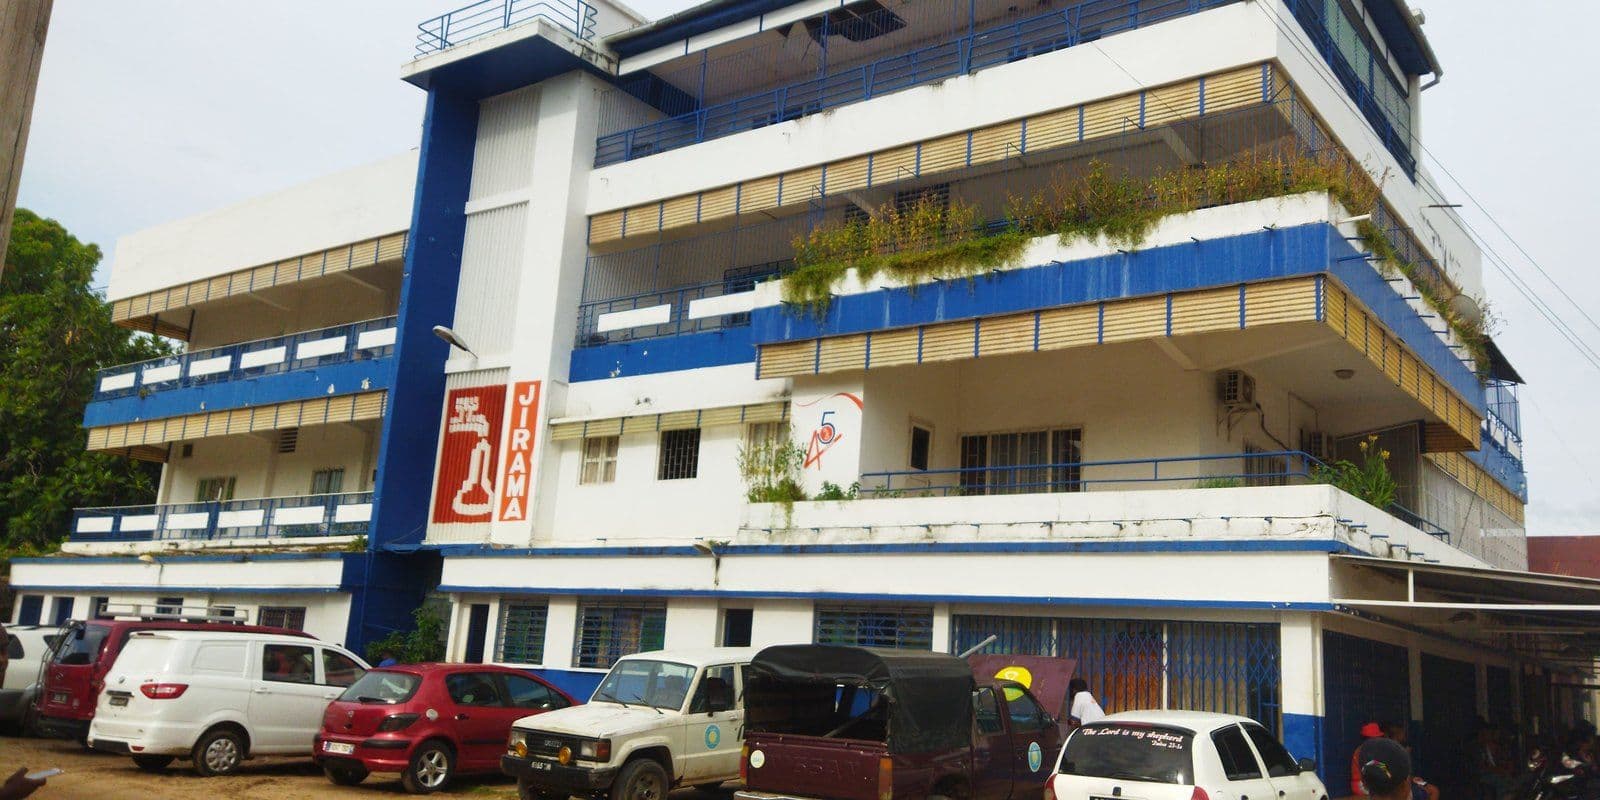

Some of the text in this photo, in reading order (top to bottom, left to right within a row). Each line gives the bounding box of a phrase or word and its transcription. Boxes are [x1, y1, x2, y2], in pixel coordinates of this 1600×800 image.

[503, 384, 536, 520] JIRAMA
[1082, 728, 1097, 736] The
[1098, 727, 1121, 736] Lord
[1131, 730, 1146, 739] my
[1146, 731, 1184, 742] shepherd
